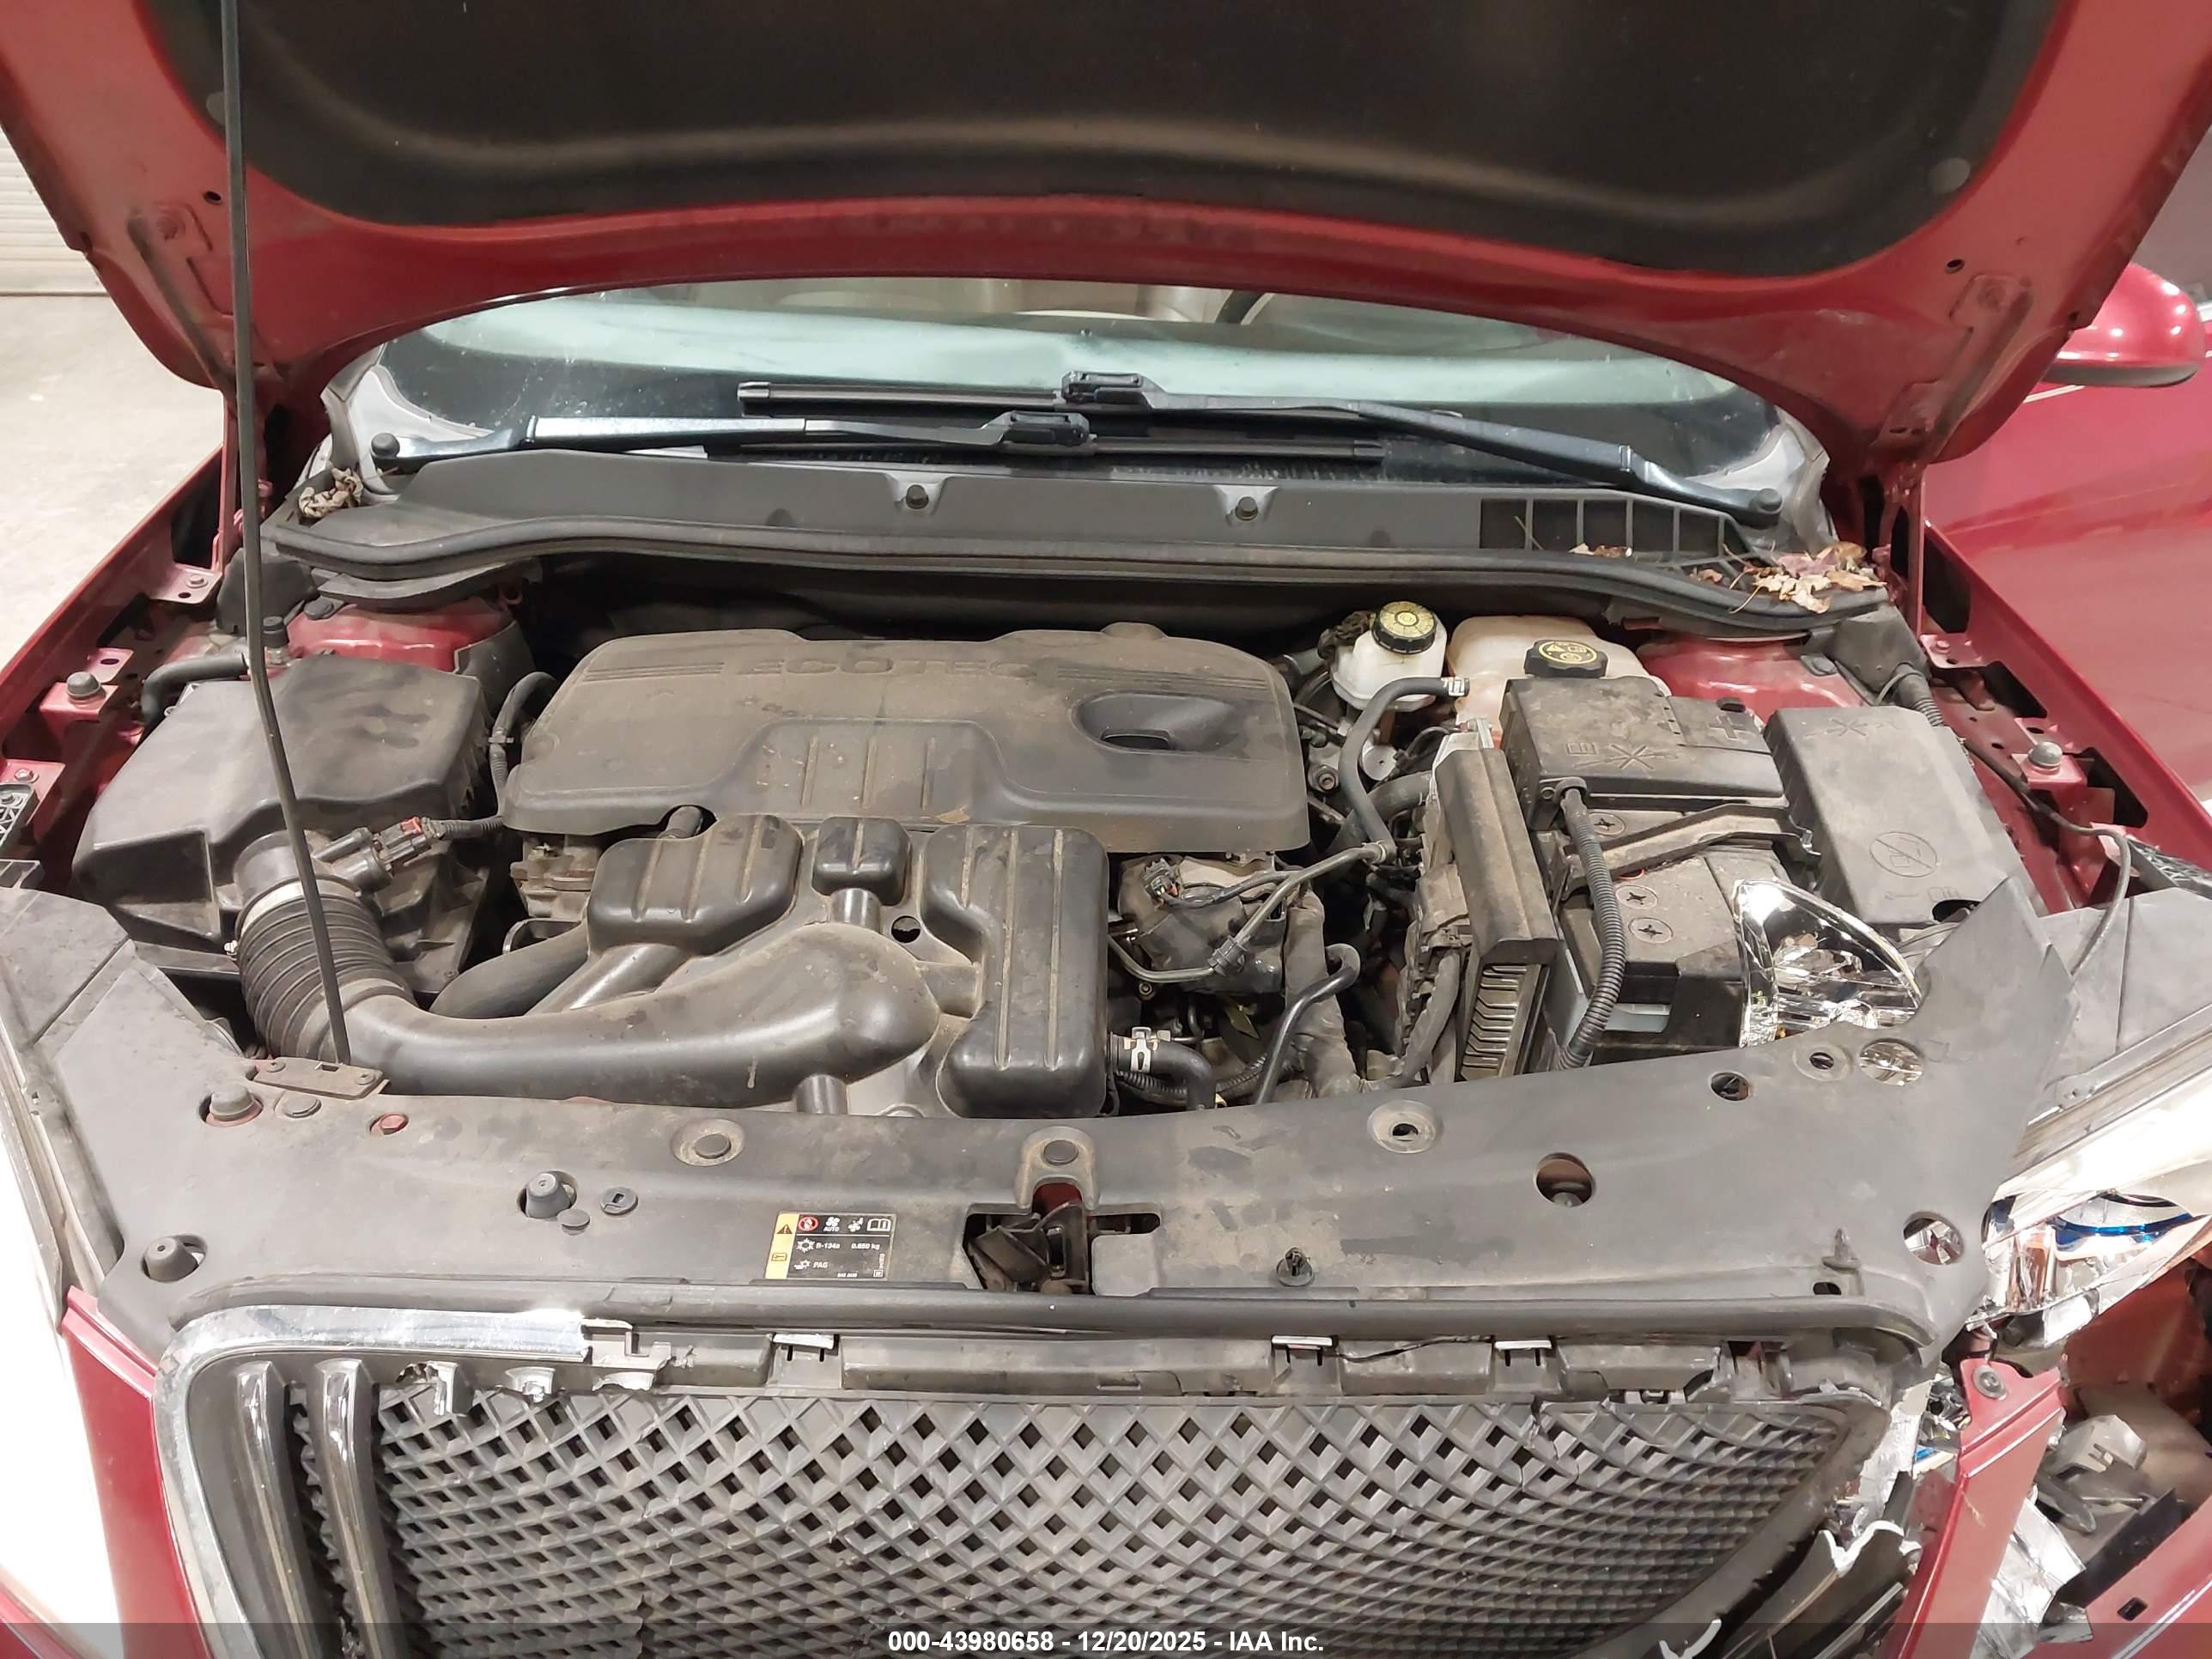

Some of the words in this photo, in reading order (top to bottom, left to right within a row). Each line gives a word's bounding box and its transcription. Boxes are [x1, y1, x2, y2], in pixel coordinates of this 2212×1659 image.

[736, 658, 1037, 679] ECOTEC
[871, 1242, 881, 1250] kg
[812, 1261, 829, 1269] PAG
